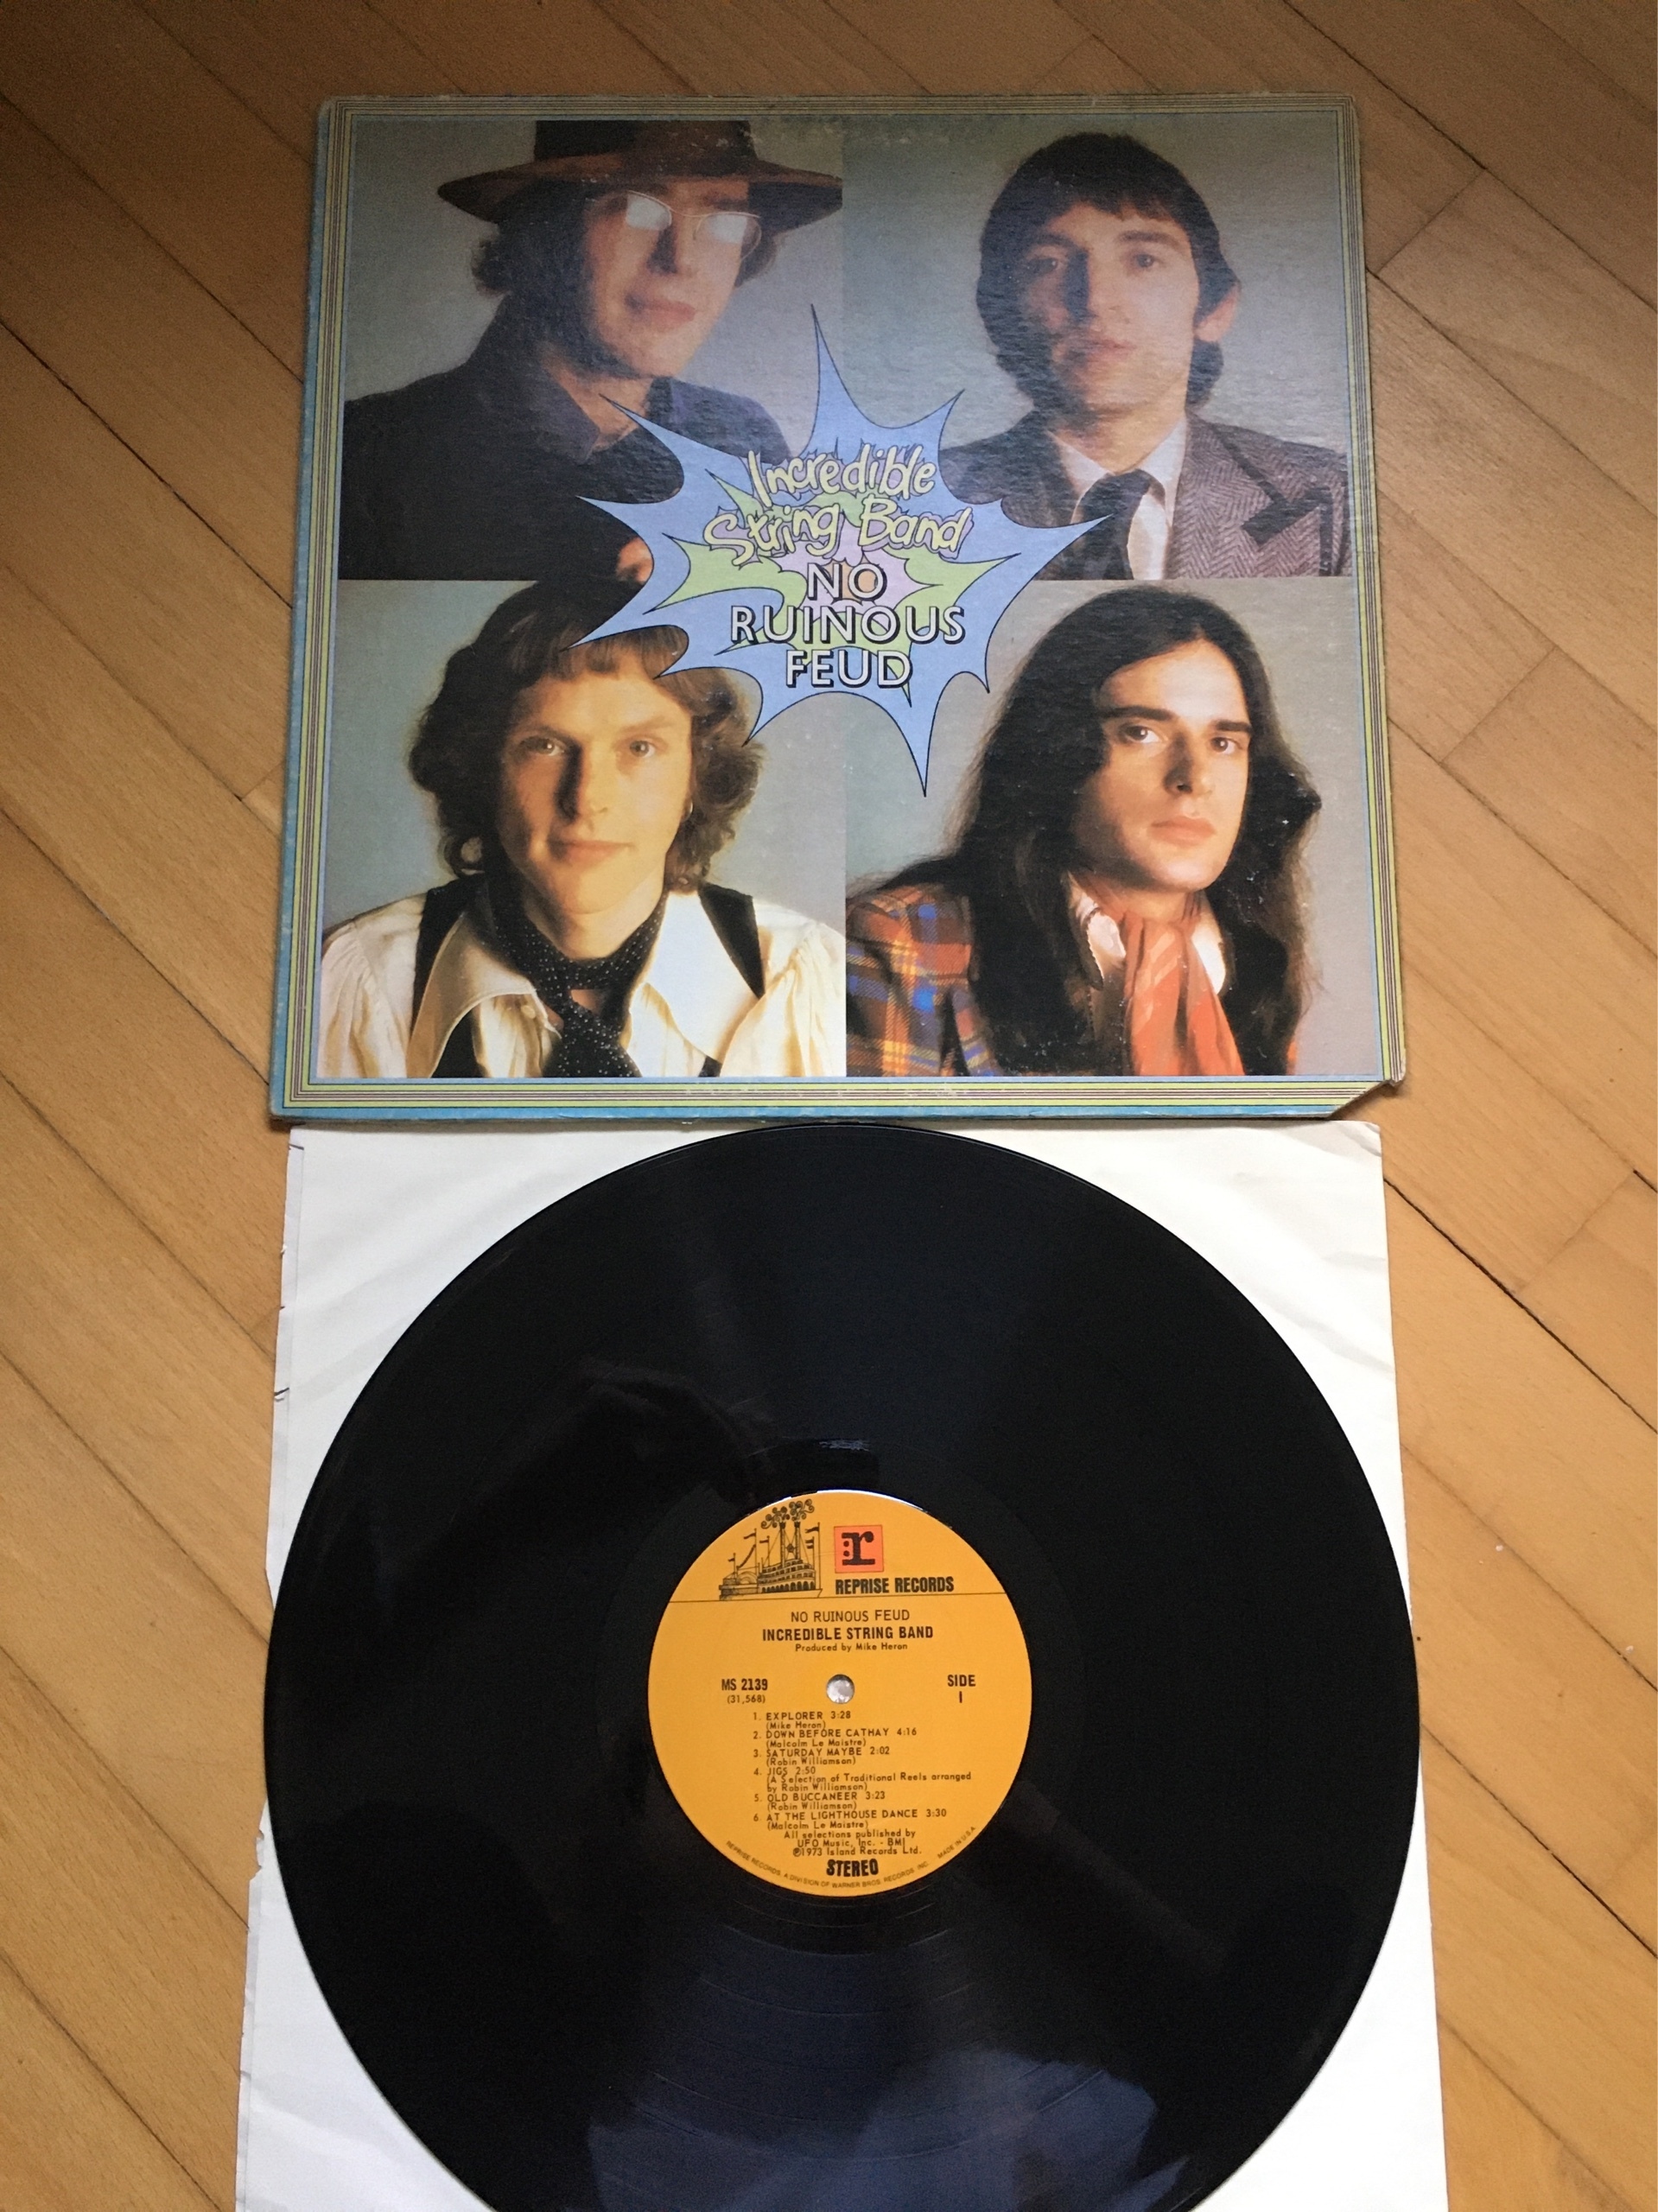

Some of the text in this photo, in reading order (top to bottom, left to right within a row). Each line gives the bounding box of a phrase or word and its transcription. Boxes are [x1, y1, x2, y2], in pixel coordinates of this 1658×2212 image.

[747, 443, 937, 508] Incredible
[703, 497, 972, 566] String Band
[807, 563, 886, 601] NO
[730, 606, 966, 645] RUINOUS
[785, 650, 912, 688] FEUD
[835, 1577, 954, 1594] REPRISE RECORDS
[791, 1610, 910, 1623] NO RUINOUS FEUD
[762, 1625, 933, 1641] INCREDIBLE STRING BAND
[795, 1643, 837, 1652] Produced
[841, 1643, 852, 1652] by
[721, 1679, 768, 1690] MS 2139
[948, 1675, 975, 1687] SIDE
[727, 1695, 765, 1704] (31,568)
[766, 1712, 823, 1720] EXPLORER
[795, 1720, 826, 1729] Heron)
[846, 1728, 890, 1737] CATHAY
[897, 1727, 917, 1736] 4:16
[767, 1776, 777, 1784] (A
[782, 1775, 826, 1783] Selection
[844, 1773, 896, 1782] Traditional
[900, 1772, 927, 1781] Reels
[931, 1772, 971, 1781] arranged
[767, 1784, 777, 1793] by
[813, 1783, 867, 1791] Williamson)
[793, 1792, 857, 1801] BUCCANEER
[866, 1791, 886, 1800] 3:23
[785, 1812, 805, 1821] THE
[811, 1810, 877, 1820] LIGHTHOUSE
[882, 1809, 918, 1818] DANCE
[767, 1821, 809, 1830] (Malcolm
[830, 1821, 868, 1829] Maistre)
[856, 1830, 900, 1839] published
[905, 1829, 915, 1839] by
[887, 1838, 905, 1847] BMI
[937, 1846, 955, 1859] MADE
[726, 1840, 749, 1861] REPRISE
[790, 1875, 819, 1886] DIVISION
[827, 1859, 879, 1877] STEREO
